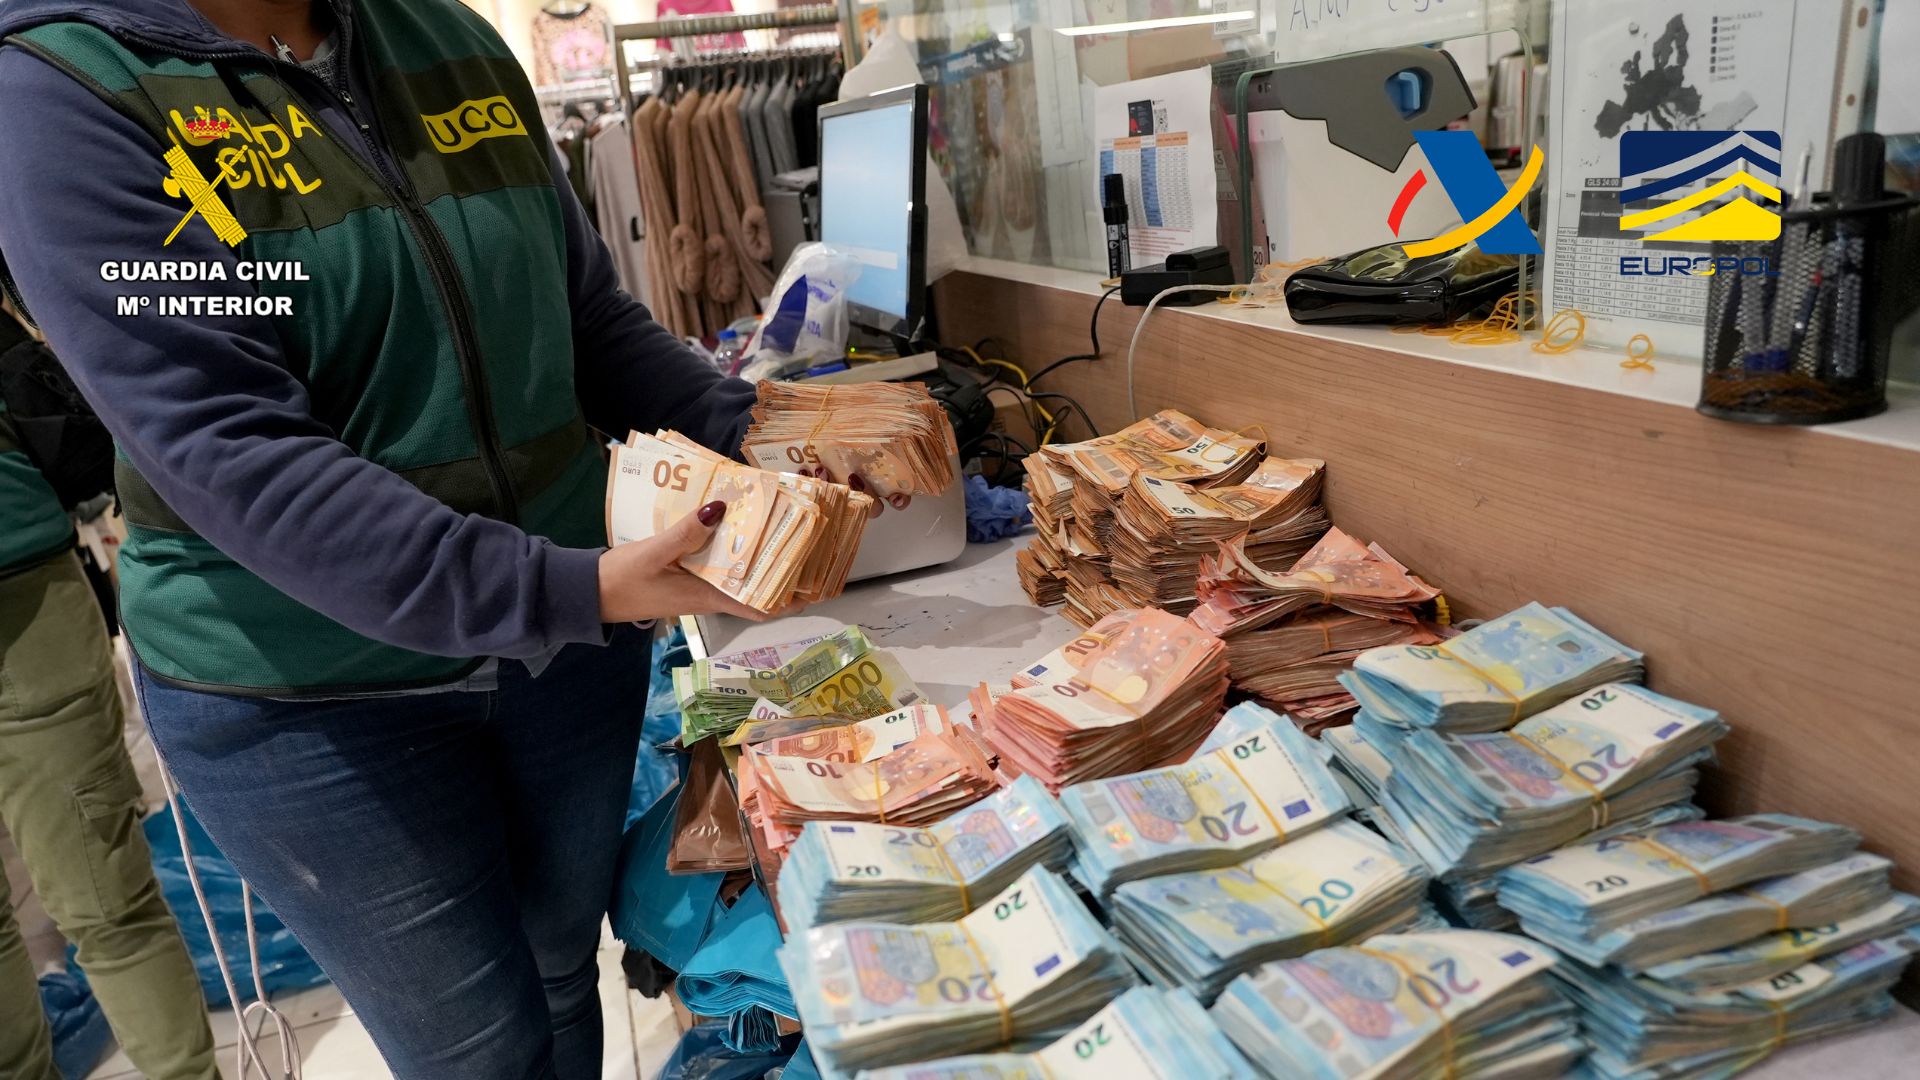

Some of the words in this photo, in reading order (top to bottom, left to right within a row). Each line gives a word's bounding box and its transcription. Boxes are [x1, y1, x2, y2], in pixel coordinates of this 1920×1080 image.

[425, 102, 518, 147] UCO
[786, 445, 821, 464] 50
[1187, 441, 1209, 454] 50
[622, 466, 641, 476] EURO
[653, 460, 691, 492] 50
[1171, 506, 1196, 515] 50
[1064, 637, 1100, 657] 10
[744, 663, 794, 681] 100
[715, 686, 748, 696] 100
[822, 661, 883, 712] 200
[1052, 679, 1092, 698] 10
[1580, 689, 1618, 711] 20
[884, 713, 907, 724] 10
[1233, 736, 1266, 760] 20
[807, 762, 843, 779] 10
[1571, 743, 1638, 785] 20
[1201, 800, 1259, 841] 20
[884, 827, 937, 849] 20
[847, 865, 882, 878] 20
[1585, 874, 1629, 894] 20
[993, 890, 1028, 921] 20
[1300, 878, 1355, 920] 20
[937, 969, 1005, 1003] 20
[1408, 957, 1480, 1010] 20
[1074, 1022, 1114, 1059] 20
